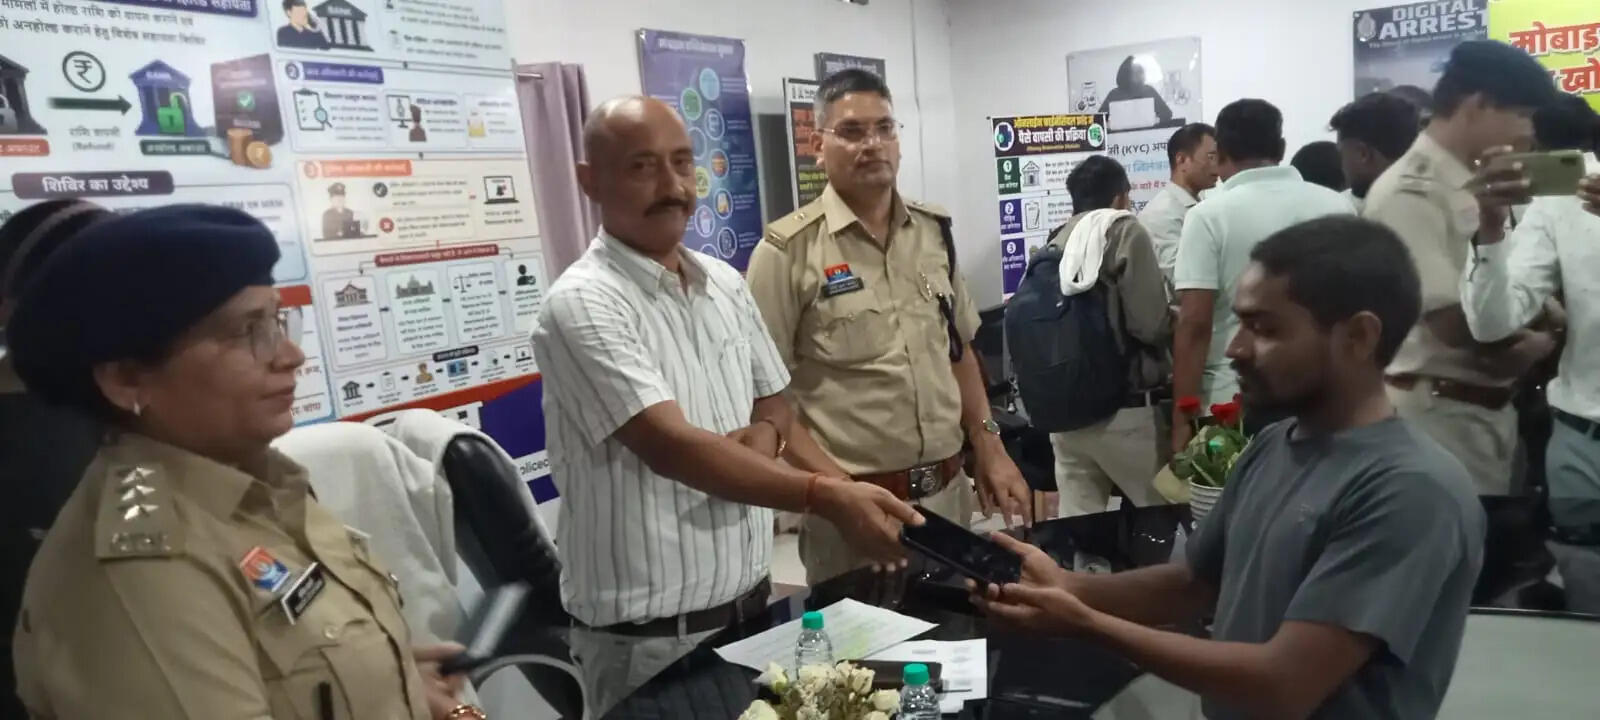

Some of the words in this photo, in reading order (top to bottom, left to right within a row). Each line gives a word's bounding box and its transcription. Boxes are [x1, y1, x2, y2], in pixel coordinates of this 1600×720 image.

[1392, 0, 1479, 21] DIGITAL
[1379, 9, 1488, 40] ARREST
[1018, 128, 1031, 144] पैसे
[1032, 128, 1053, 143] वापसी
[1054, 127, 1064, 142] की
[1122, 143, 1150, 156] (KYC)
[42, 176, 86, 193] शिविर
[90, 180, 109, 191] का
[112, 176, 149, 192] उद्देश्य
